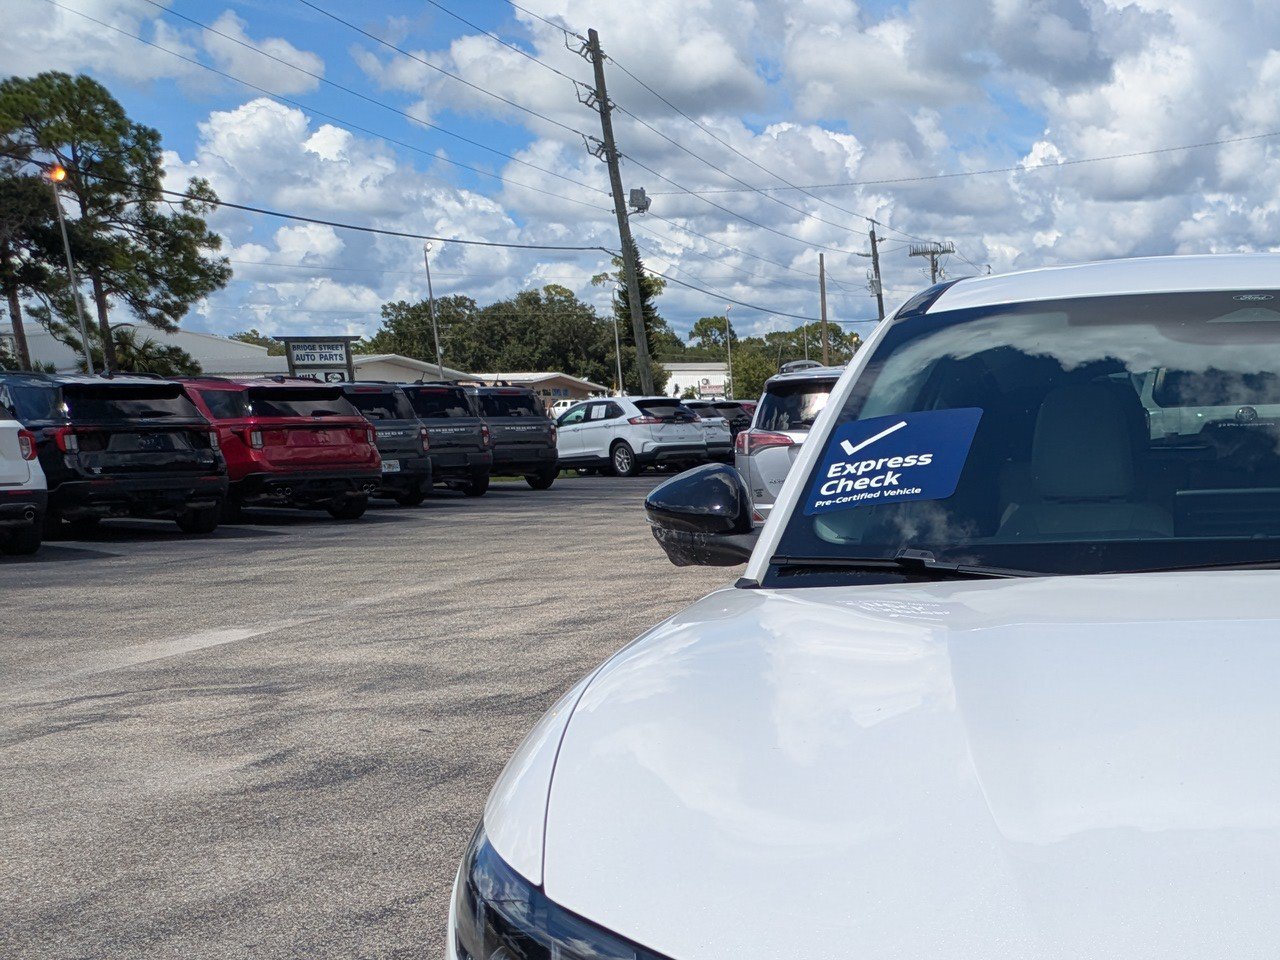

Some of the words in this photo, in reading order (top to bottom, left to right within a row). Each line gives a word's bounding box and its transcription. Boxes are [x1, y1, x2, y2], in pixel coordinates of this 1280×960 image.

[826, 453, 933, 478] Express
[820, 471, 902, 496] Check
[814, 491, 880, 508] Pre-Certified
[883, 487, 922, 497] Vehicle
